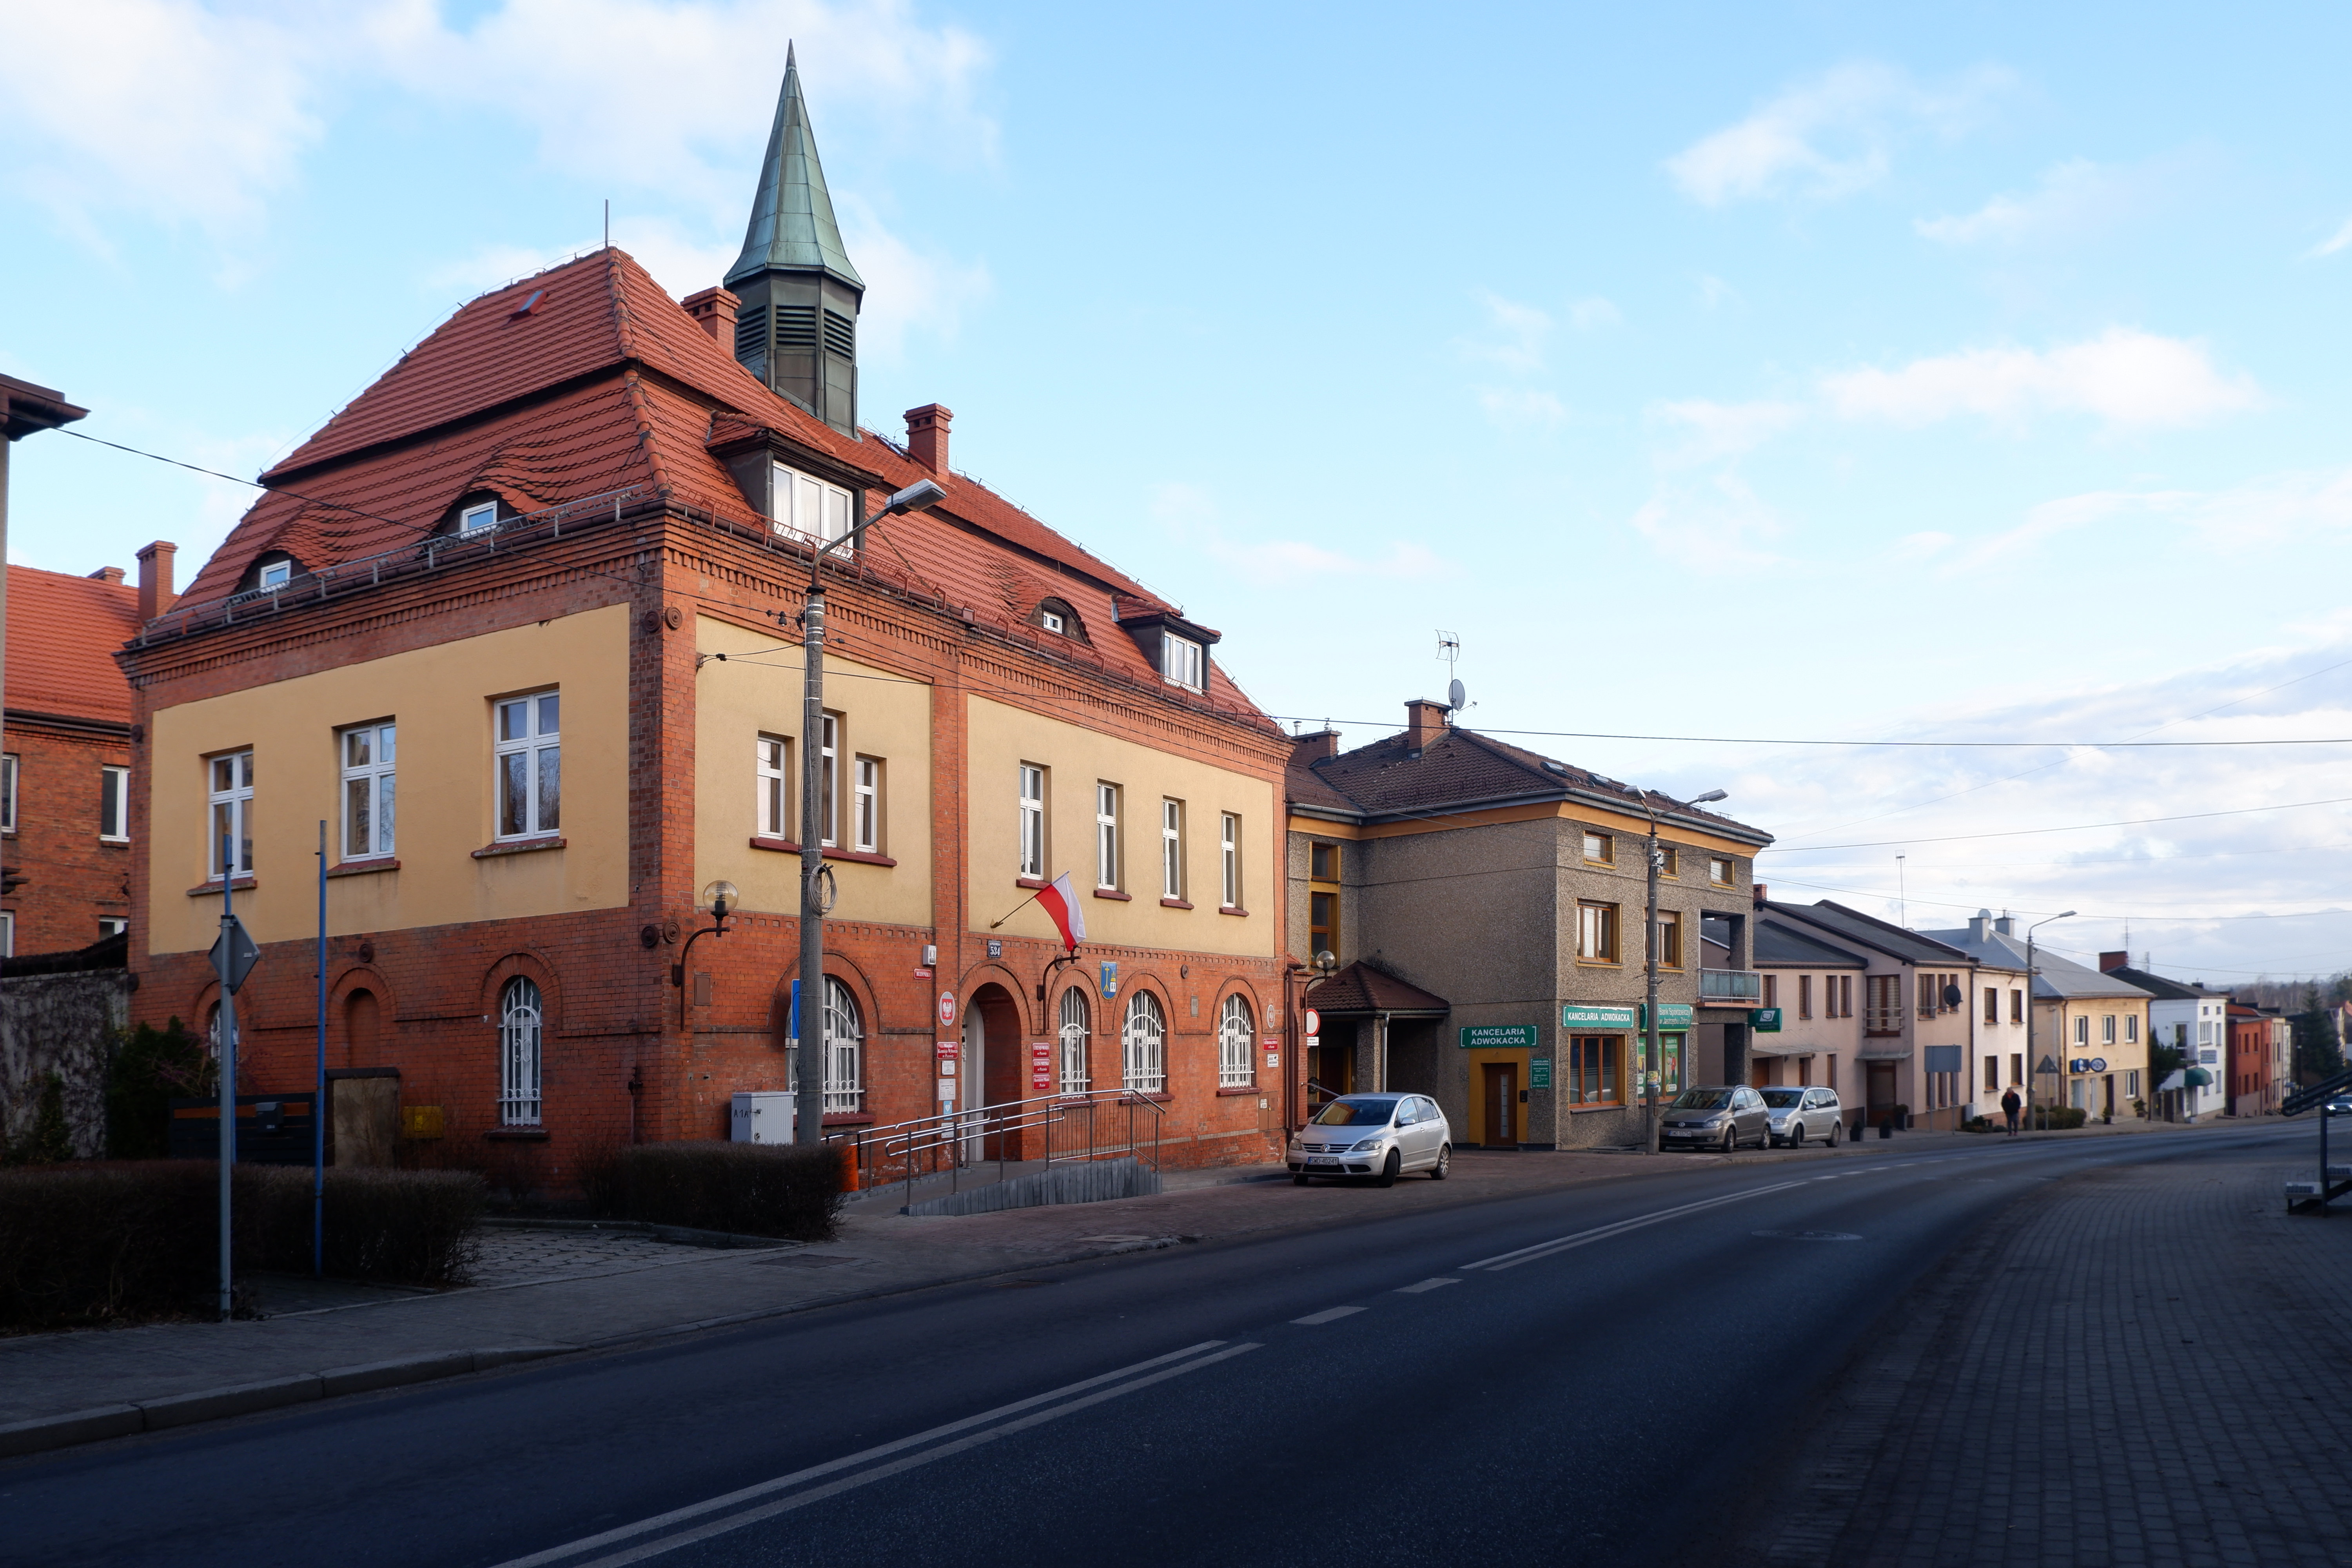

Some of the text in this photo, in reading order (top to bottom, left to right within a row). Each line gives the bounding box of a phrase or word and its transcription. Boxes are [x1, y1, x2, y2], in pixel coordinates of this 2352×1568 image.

[990, 946, 1000, 956] 534
[1669, 1007, 1690, 1017] Spółdzielczy
[1568, 1012, 1630, 1022] KANCELARIA ADWOKACKA
[1663, 1017, 1680, 1026] Jastrzębiu
[1472, 1028, 1525, 1036] KANCELARIA
[1471, 1037, 1526, 1045] ADWOKACKA
